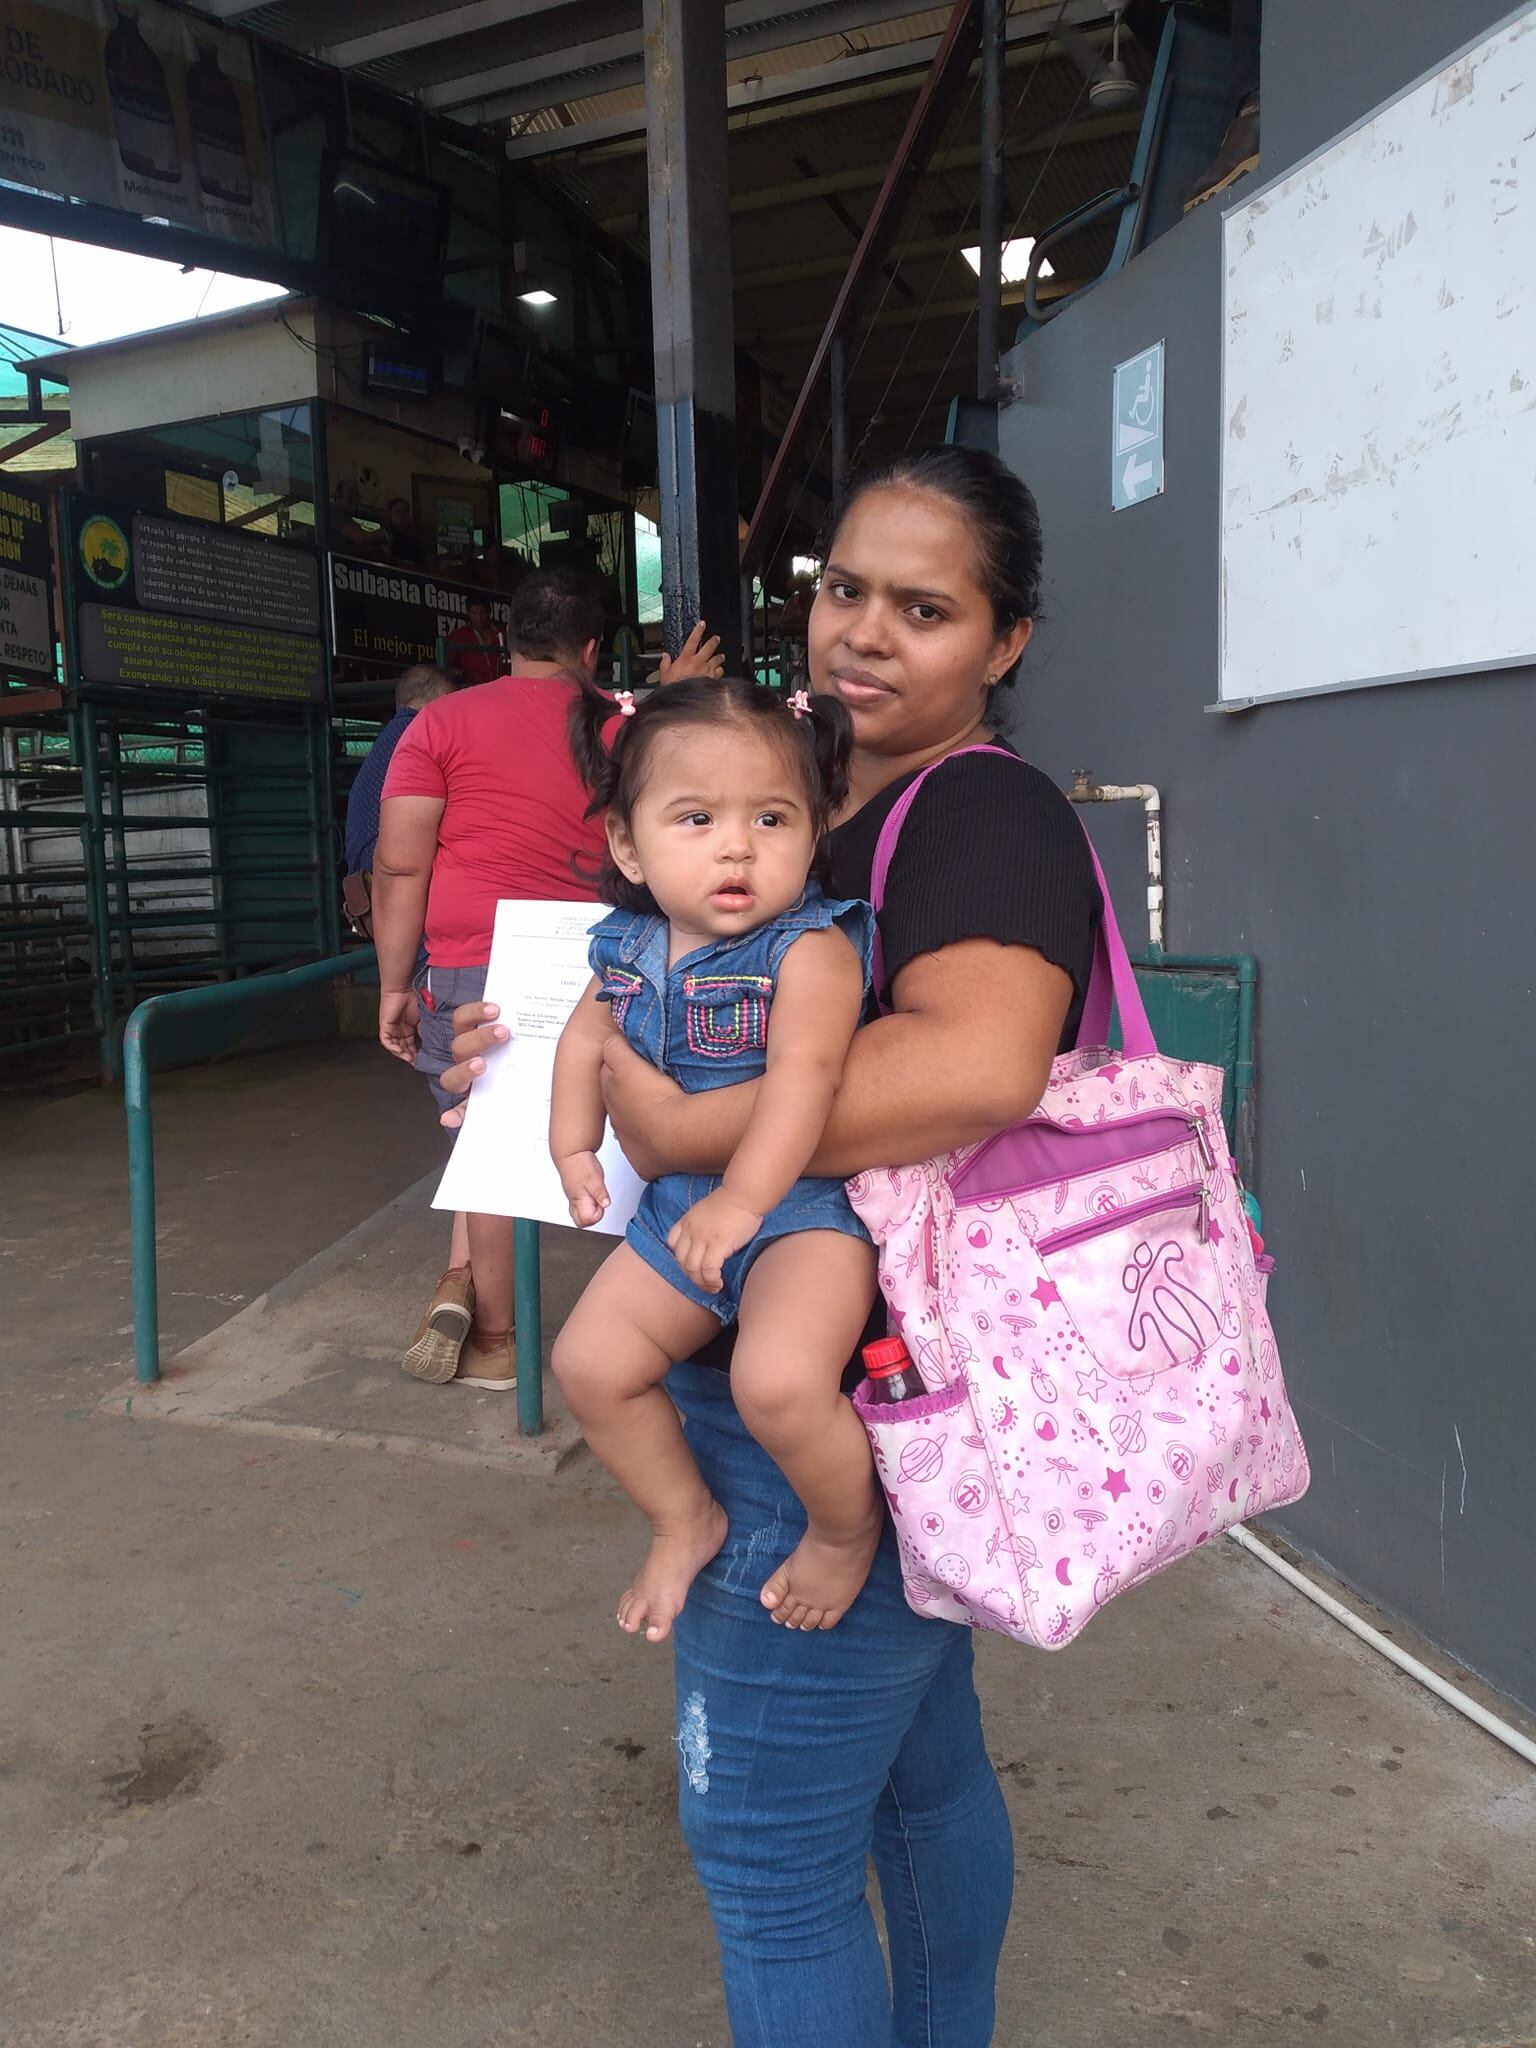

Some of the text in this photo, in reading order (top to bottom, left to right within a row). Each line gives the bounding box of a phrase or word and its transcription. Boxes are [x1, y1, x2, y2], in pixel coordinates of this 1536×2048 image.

[6, 25, 43, 62] DE
[0, 490, 43, 524] AMOS EL
[11, 517, 24, 540] DE
[335, 563, 421, 606] Subasta
[103, 623, 118, 635] las
[119, 627, 185, 644] consecuencias
[187, 635, 197, 645] de
[199, 638, 209, 648] su
[124, 613, 178, 630] considerado
[181, 622, 191, 631] un
[194, 623, 210, 635] acto
[224, 628, 243, 640] mala
[107, 638, 141, 653] cumpla
[143, 645, 160, 655] con
[162, 647, 173, 656] su
[354, 628, 440, 662] El mejor pu
[119, 667, 173, 683] Exonerando
[181, 675, 190, 684] la
[191, 675, 225, 691] Subasta
[236, 681, 253, 692] toda
[122, 655, 153, 667] asume
[154, 658, 174, 669] toda
[176, 661, 240, 680] responsabilidad
